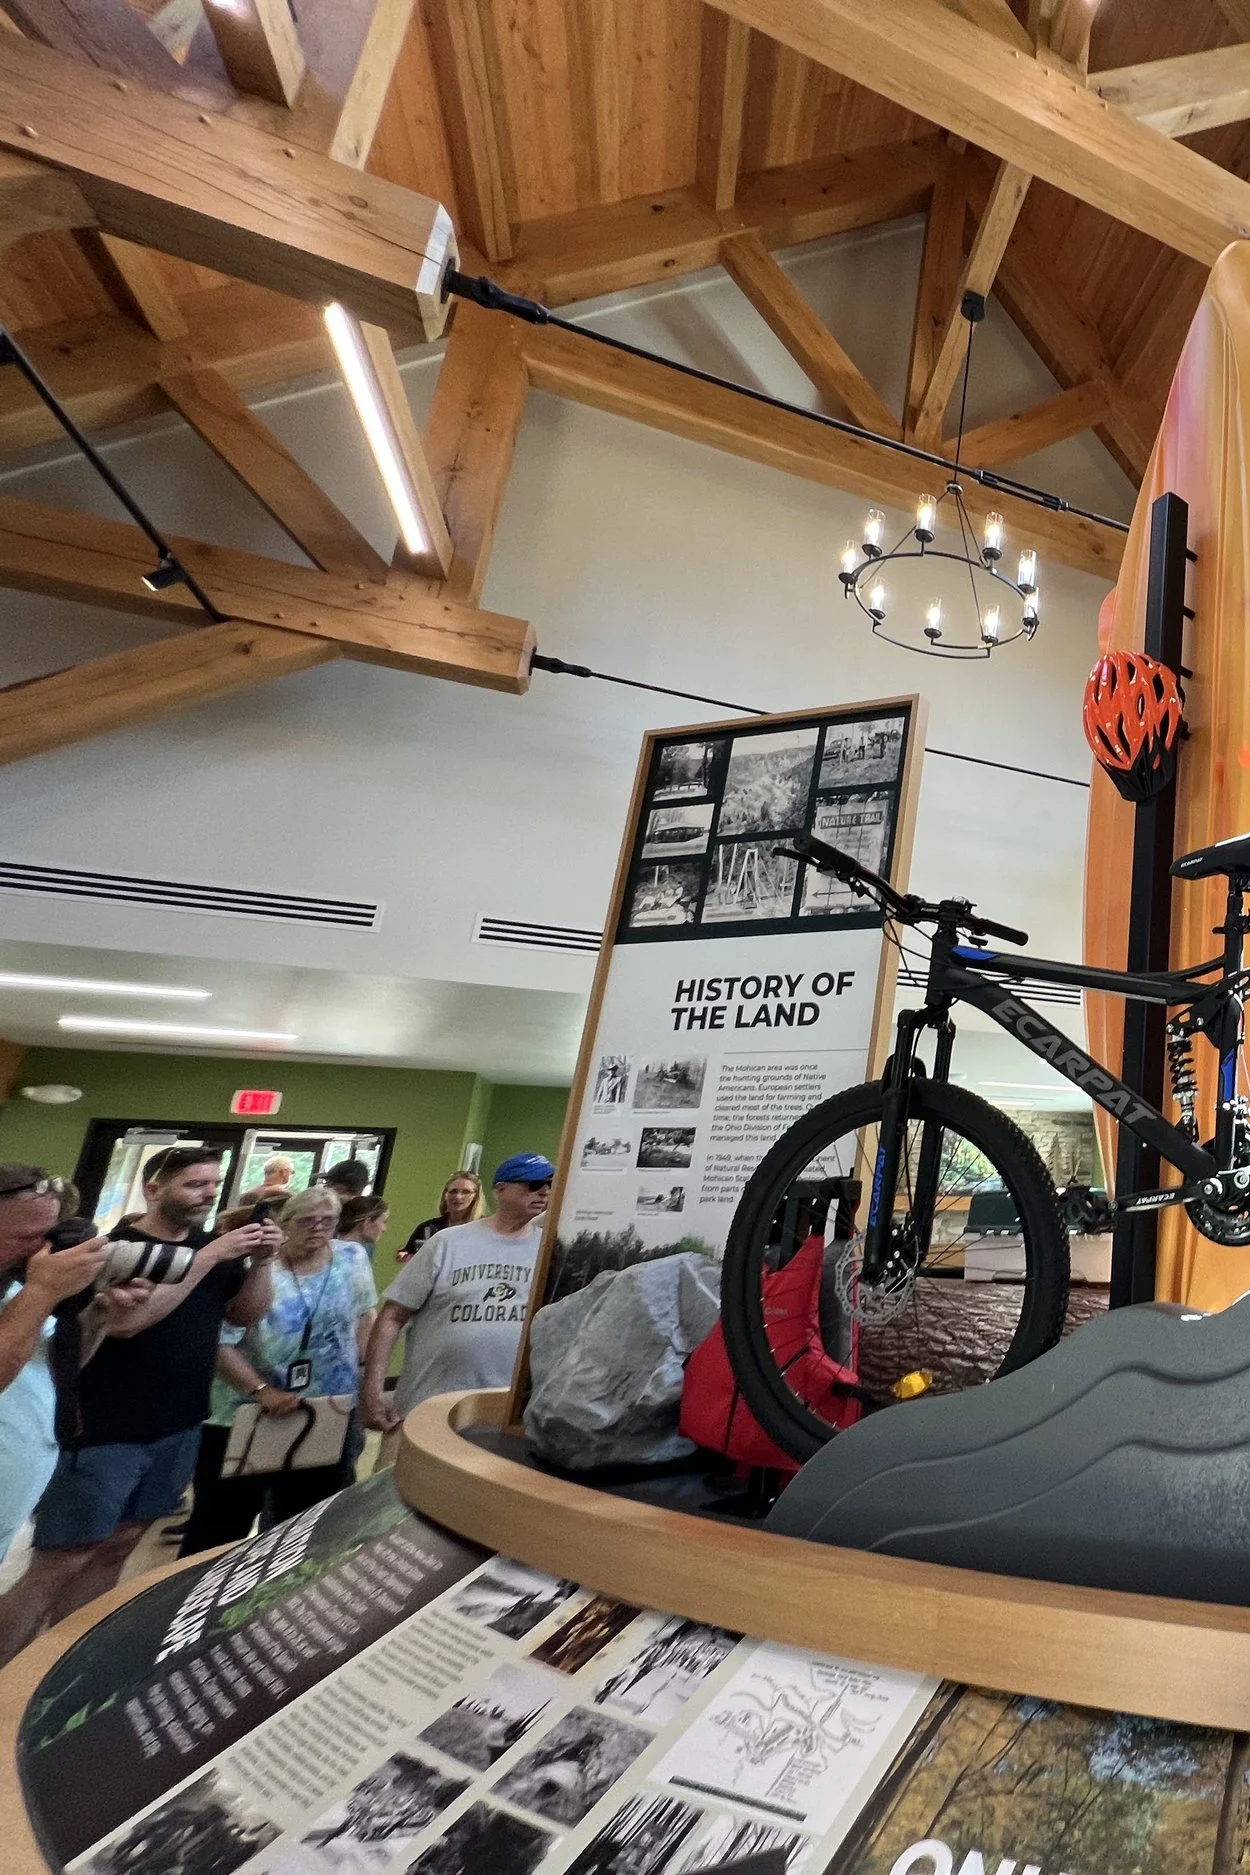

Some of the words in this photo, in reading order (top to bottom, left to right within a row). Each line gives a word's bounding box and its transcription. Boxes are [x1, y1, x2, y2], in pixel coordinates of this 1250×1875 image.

[822, 815, 857, 827] NATURE
[675, 973, 805, 1002] HISTORY
[811, 971, 855, 997] OF
[671, 1006, 727, 1031] THE
[735, 1002, 820, 1028] LAND
[992, 999, 1157, 1124] ECARPAT
[735, 1064, 766, 1072] Mohican
[733, 1075, 760, 1083] hunting
[763, 1074, 793, 1083] grounds
[758, 1084, 793, 1092] European
[239, 1092, 275, 1112] EXIT
[717, 1094, 734, 1102] used
[777, 1093, 806, 1102] farming
[710, 1134, 744, 1143] managed
[713, 1164, 741, 1172] Natural
[720, 1185, 740, 1193] parts
[452, 1263, 531, 1286] UNIVERSITY
[450, 1304, 527, 1322] COLORAD
